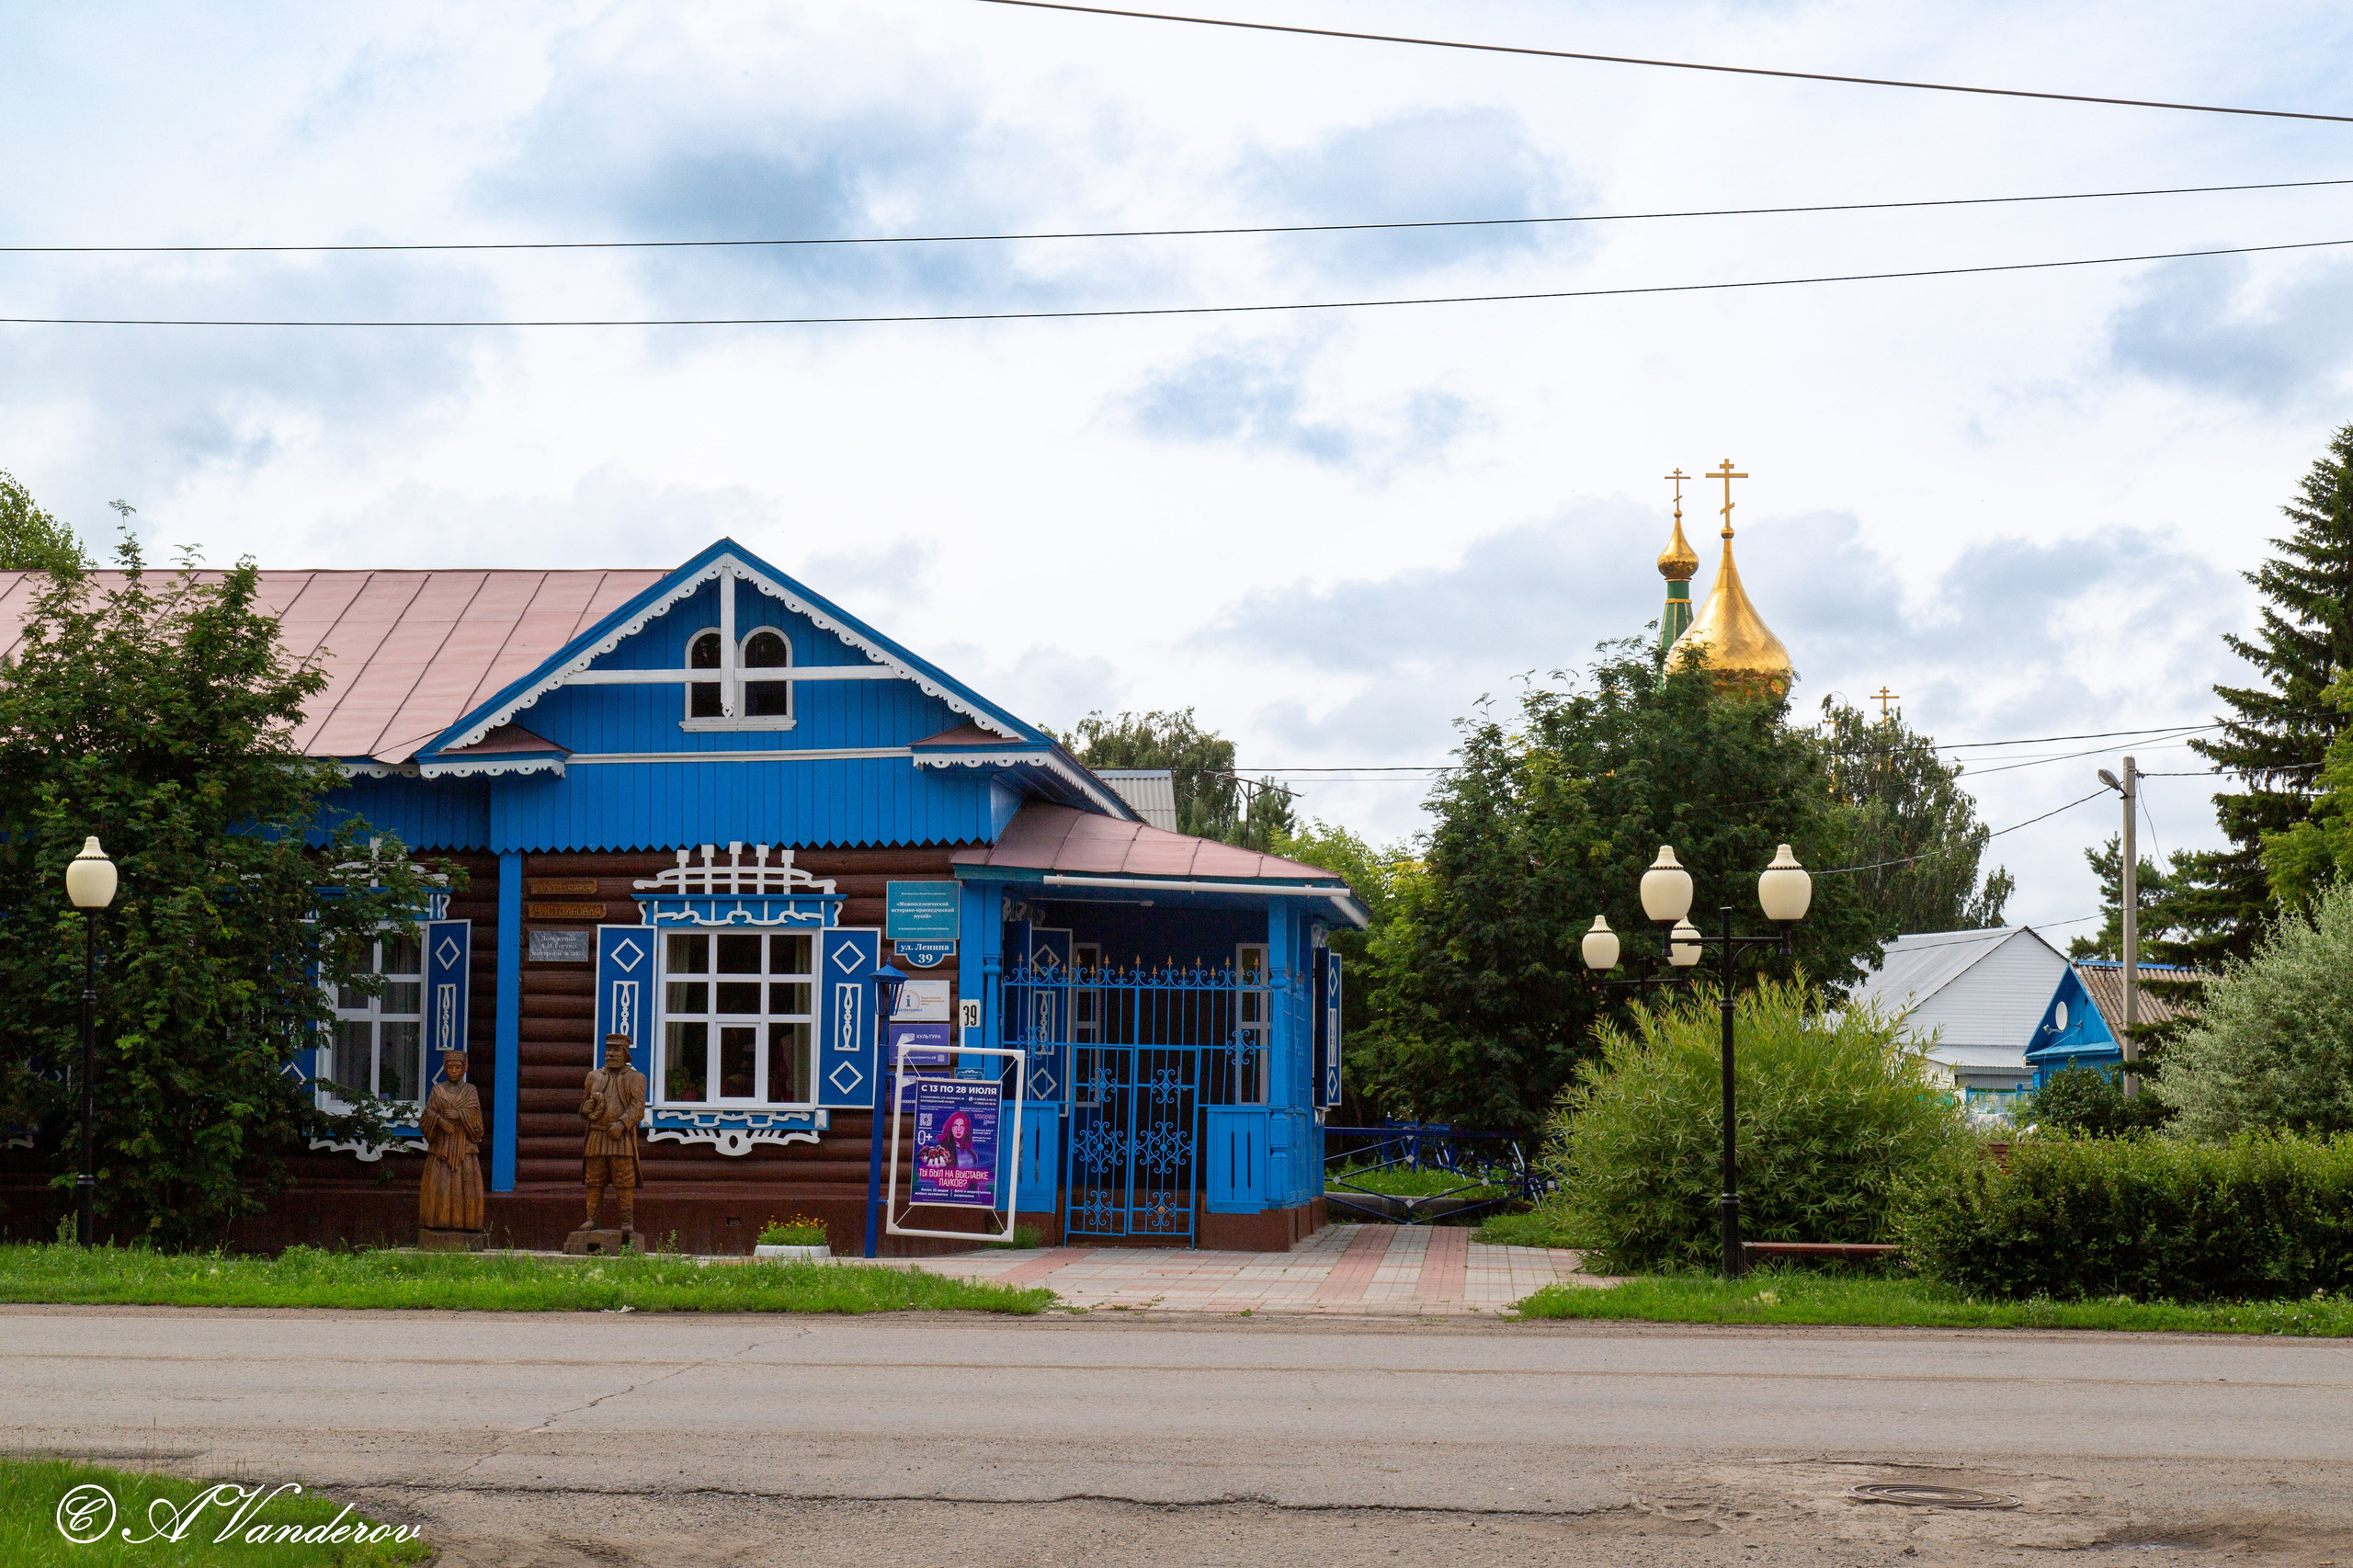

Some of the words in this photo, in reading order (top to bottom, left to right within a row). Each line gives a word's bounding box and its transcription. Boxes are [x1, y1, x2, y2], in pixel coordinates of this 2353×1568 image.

[915, 943, 949, 951] Ленина
[918, 953, 933, 964] 39
[962, 1005, 977, 1026] 39
[969, 1086, 997, 1095] ИЮЛЯ
[917, 1130, 933, 1145] 0+
[918, 1168, 928, 1176] ТЫ
[928, 1169, 944, 1177] БЫЛ
[944, 1169, 954, 1178] НА
[955, 1170, 989, 1180] ВЫСТАВКЕ
[938, 1177, 968, 1187] ПАУКОВ?
